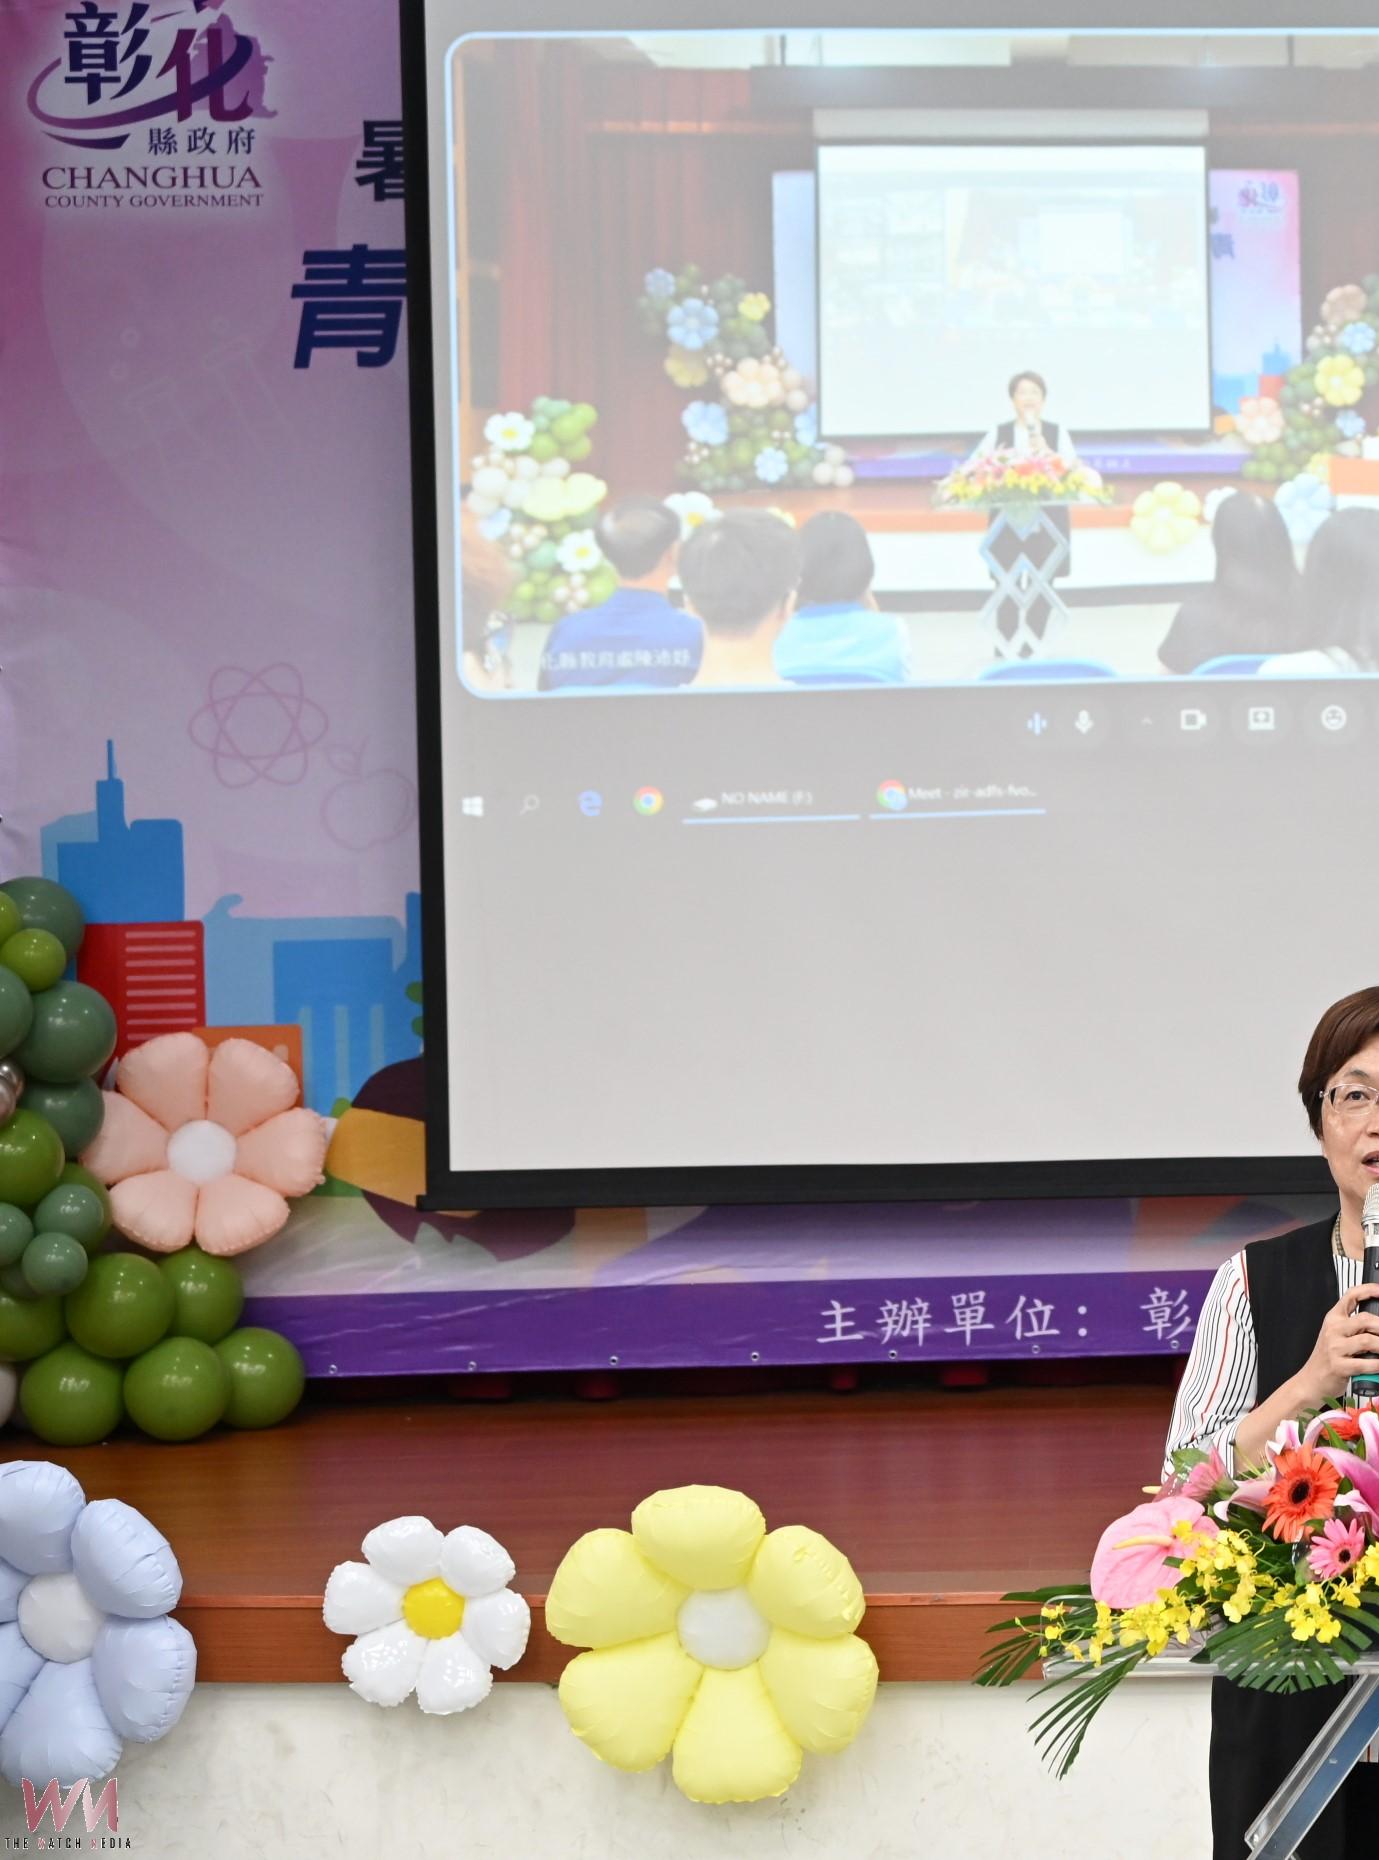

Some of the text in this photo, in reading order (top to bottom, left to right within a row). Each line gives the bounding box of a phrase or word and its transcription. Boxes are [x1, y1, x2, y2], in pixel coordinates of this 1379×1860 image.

[64, 0, 253, 122] 彰化
[147, 126, 256, 156] 縣政府
[42, 166, 262, 190] CHANGHUA
[45, 193, 264, 208] COUNTY GOVERNMENT
[291, 244, 407, 369] 青
